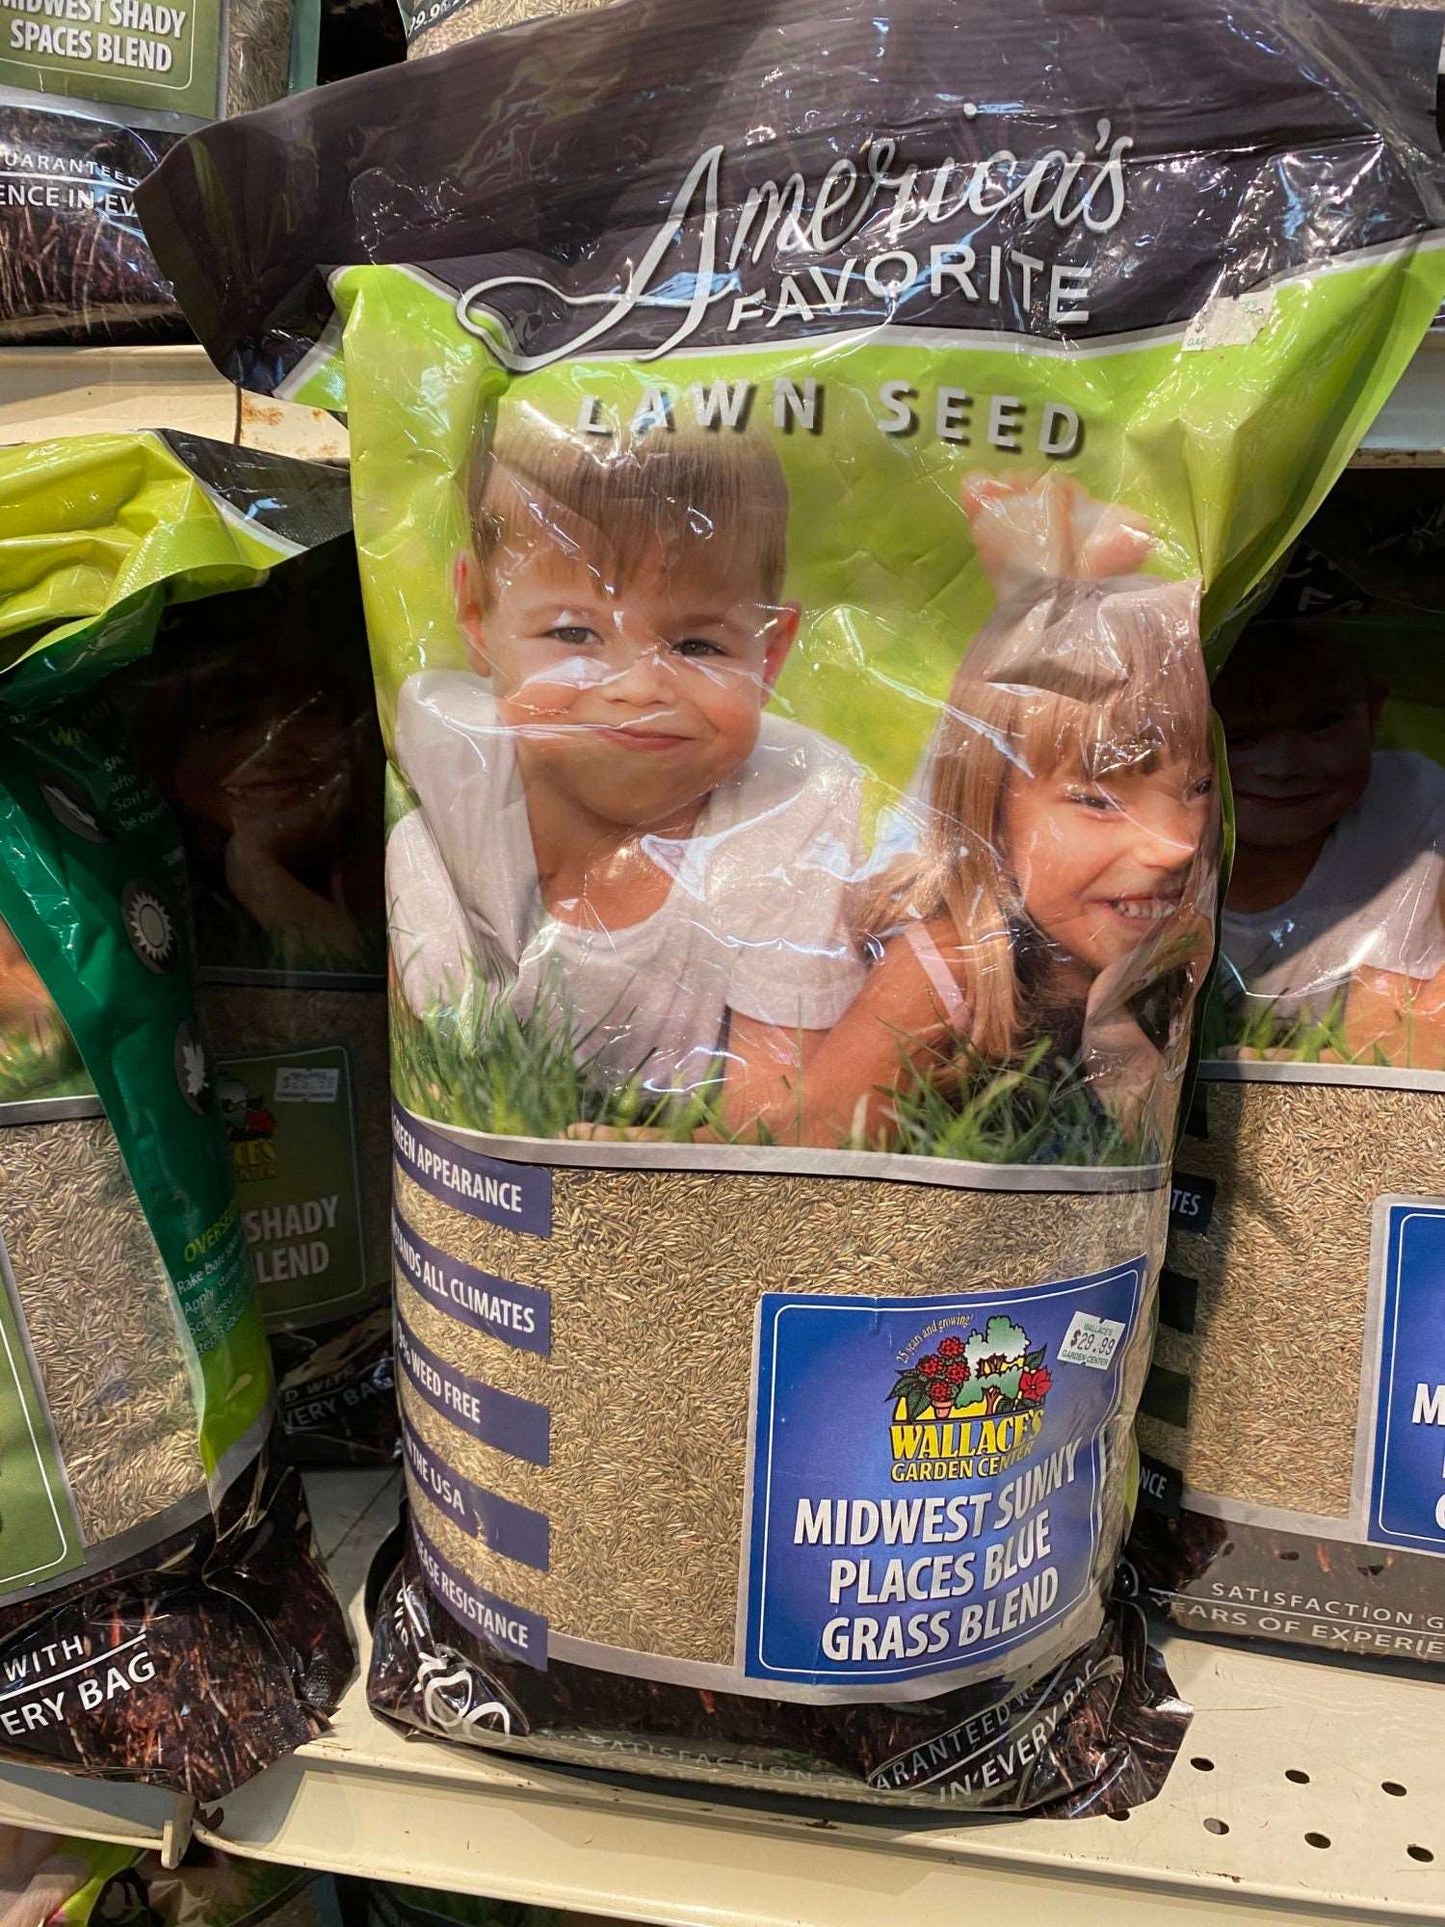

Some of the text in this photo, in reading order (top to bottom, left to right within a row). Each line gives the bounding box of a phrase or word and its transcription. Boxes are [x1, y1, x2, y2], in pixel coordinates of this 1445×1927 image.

[10, 18, 172, 72] SPACES BLEND
[108, 0, 185, 38] SHADY
[68, 188, 94, 210] IN
[457, 103, 1133, 372] America's
[727, 244, 1093, 332] FAVORITE
[576, 378, 1086, 458] LAWN SEED
[418, 1145, 522, 1213] APPEARANCE
[244, 1195, 338, 1244] SHADY
[423, 1259, 448, 1298] ALL
[450, 1278, 536, 1334] CLIMATES
[922, 1319, 938, 1338] and
[1070, 1329, 1115, 1356] $29.99
[411, 1348, 481, 1425] WEED FREE
[889, 1408, 1045, 1461] WALLACE'S
[891, 1440, 1036, 1482] GARDEN CENTER
[412, 1442, 429, 1482] THE
[431, 1466, 465, 1515] USA
[794, 1438, 1081, 1546] MIDWEST SUNNY
[829, 1510, 1052, 1605] PLACES BLUE
[441, 1571, 529, 1650] RESISTANCE
[821, 1566, 1060, 1663] GRASS BLEND
[1212, 1582, 1413, 1626] SATISFACTION
[1258, 1616, 1301, 1634] OF
[3, 1634, 84, 1681] WITH
[78, 1651, 155, 1711] BAG
[981, 1705, 1058, 1790] EVERY
